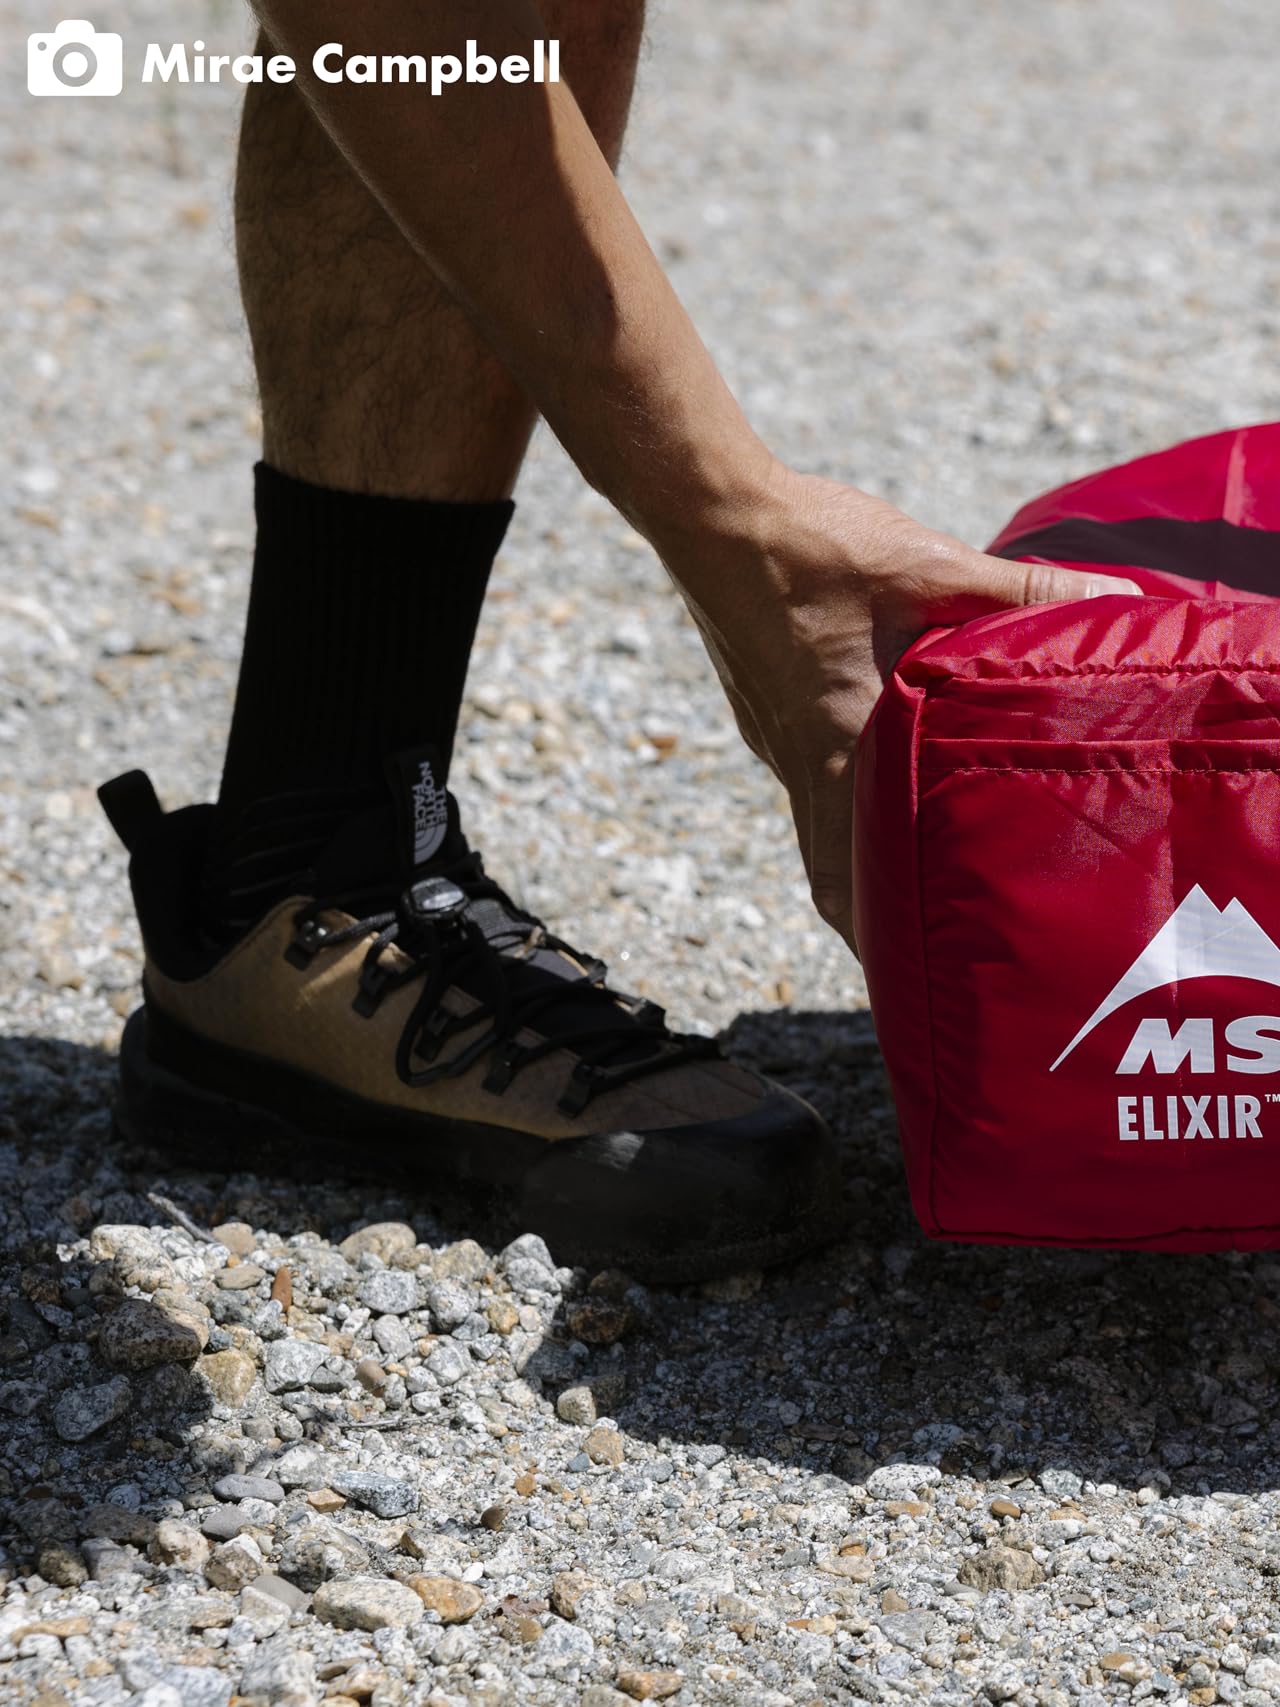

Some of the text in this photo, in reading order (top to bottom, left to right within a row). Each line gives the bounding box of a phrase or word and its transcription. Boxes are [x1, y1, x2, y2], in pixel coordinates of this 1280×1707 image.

[412, 783, 426, 832] FACE
[418, 761, 438, 828] NORTH
[435, 785, 448, 825] THE
